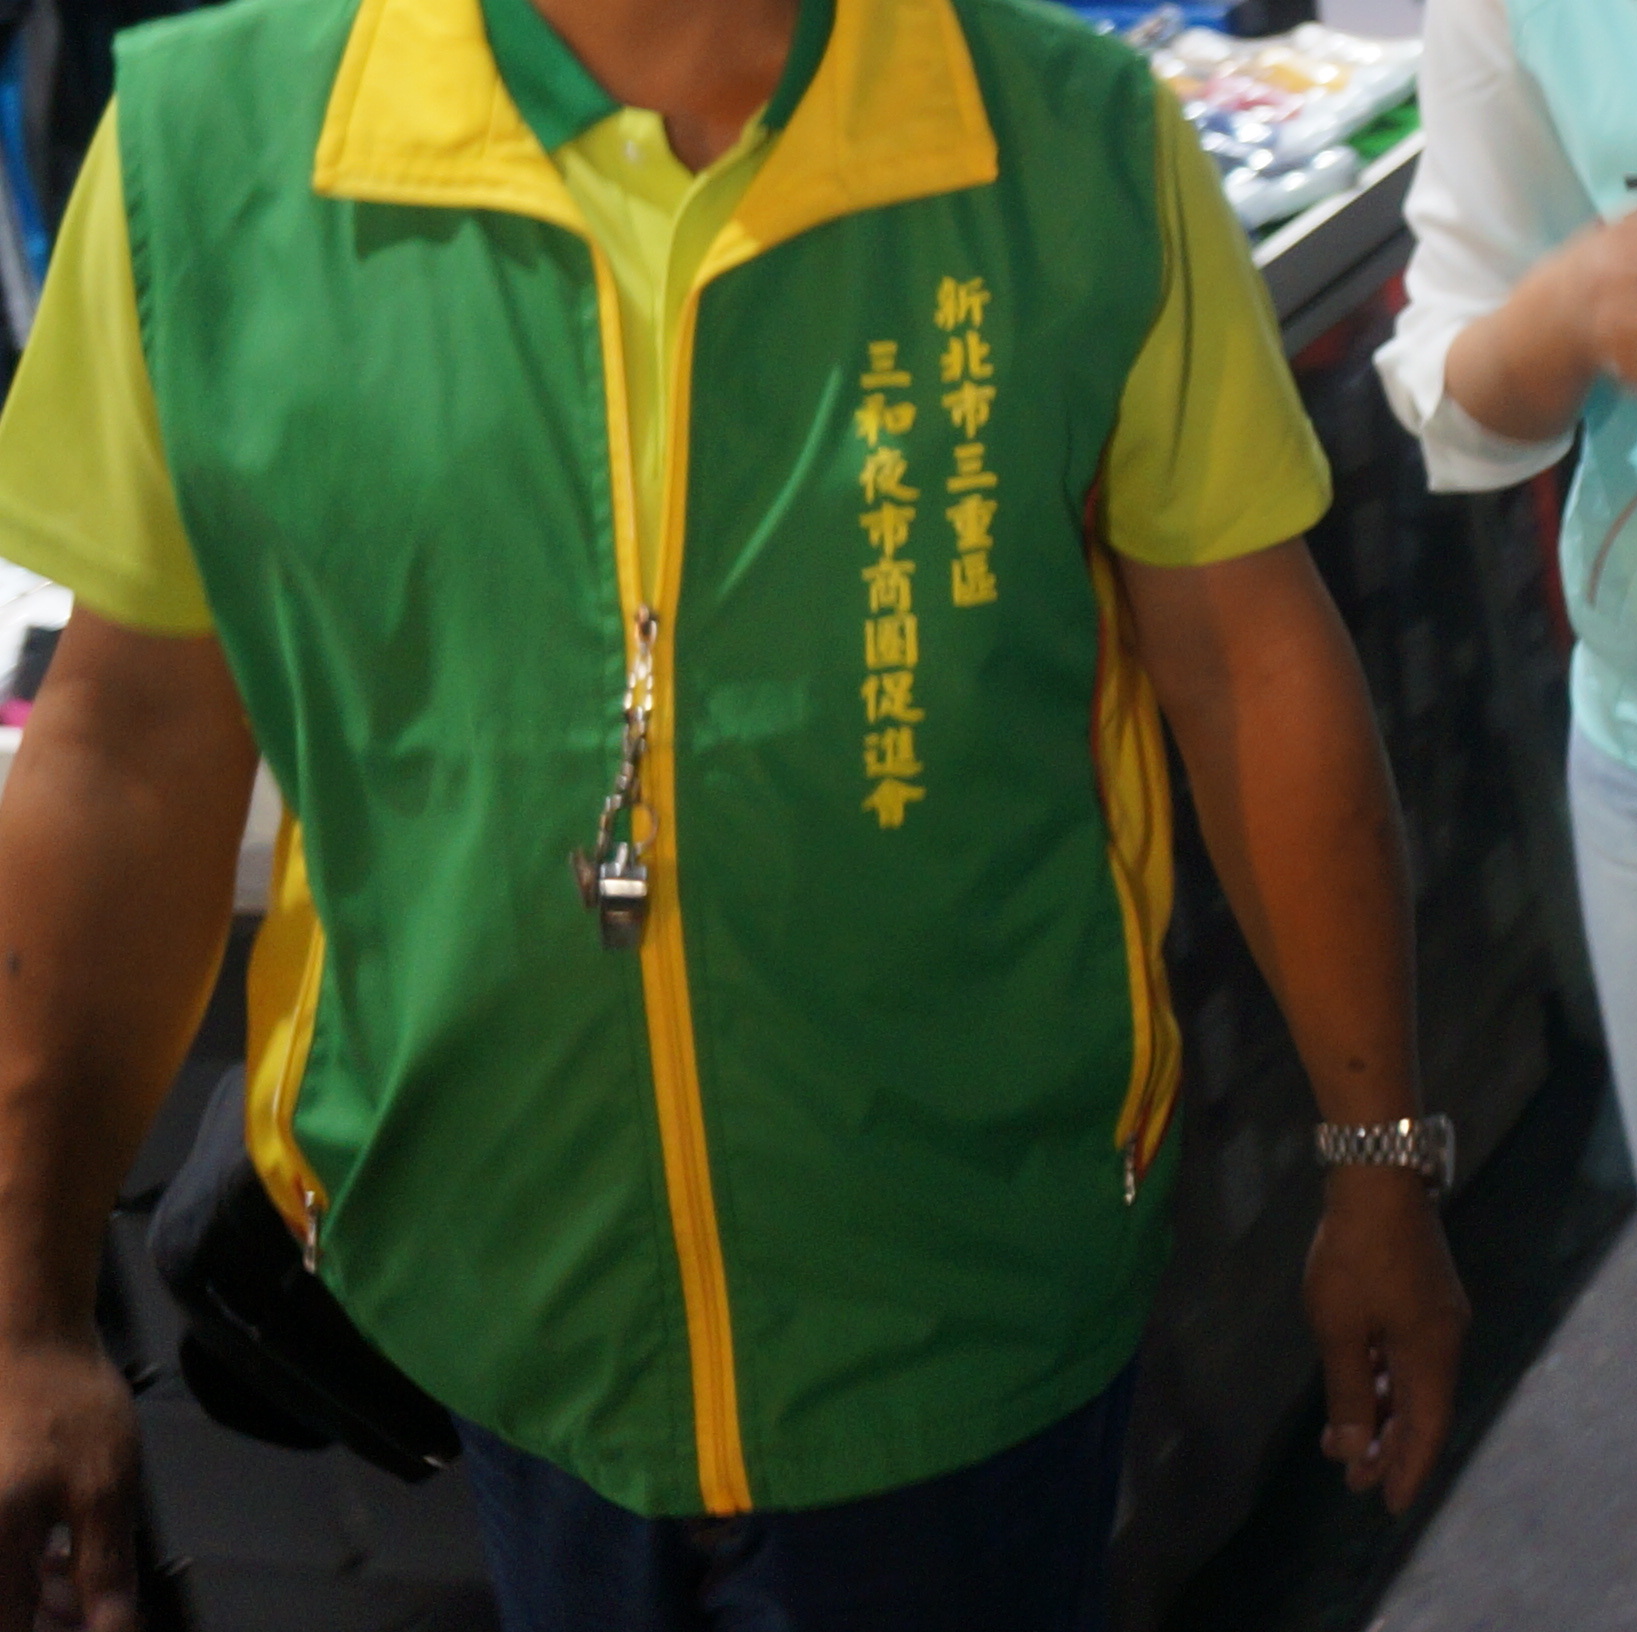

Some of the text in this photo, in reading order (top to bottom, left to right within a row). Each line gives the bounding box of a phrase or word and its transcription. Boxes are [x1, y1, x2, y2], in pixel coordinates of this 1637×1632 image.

[934, 276, 998, 608] 新北市三重區
